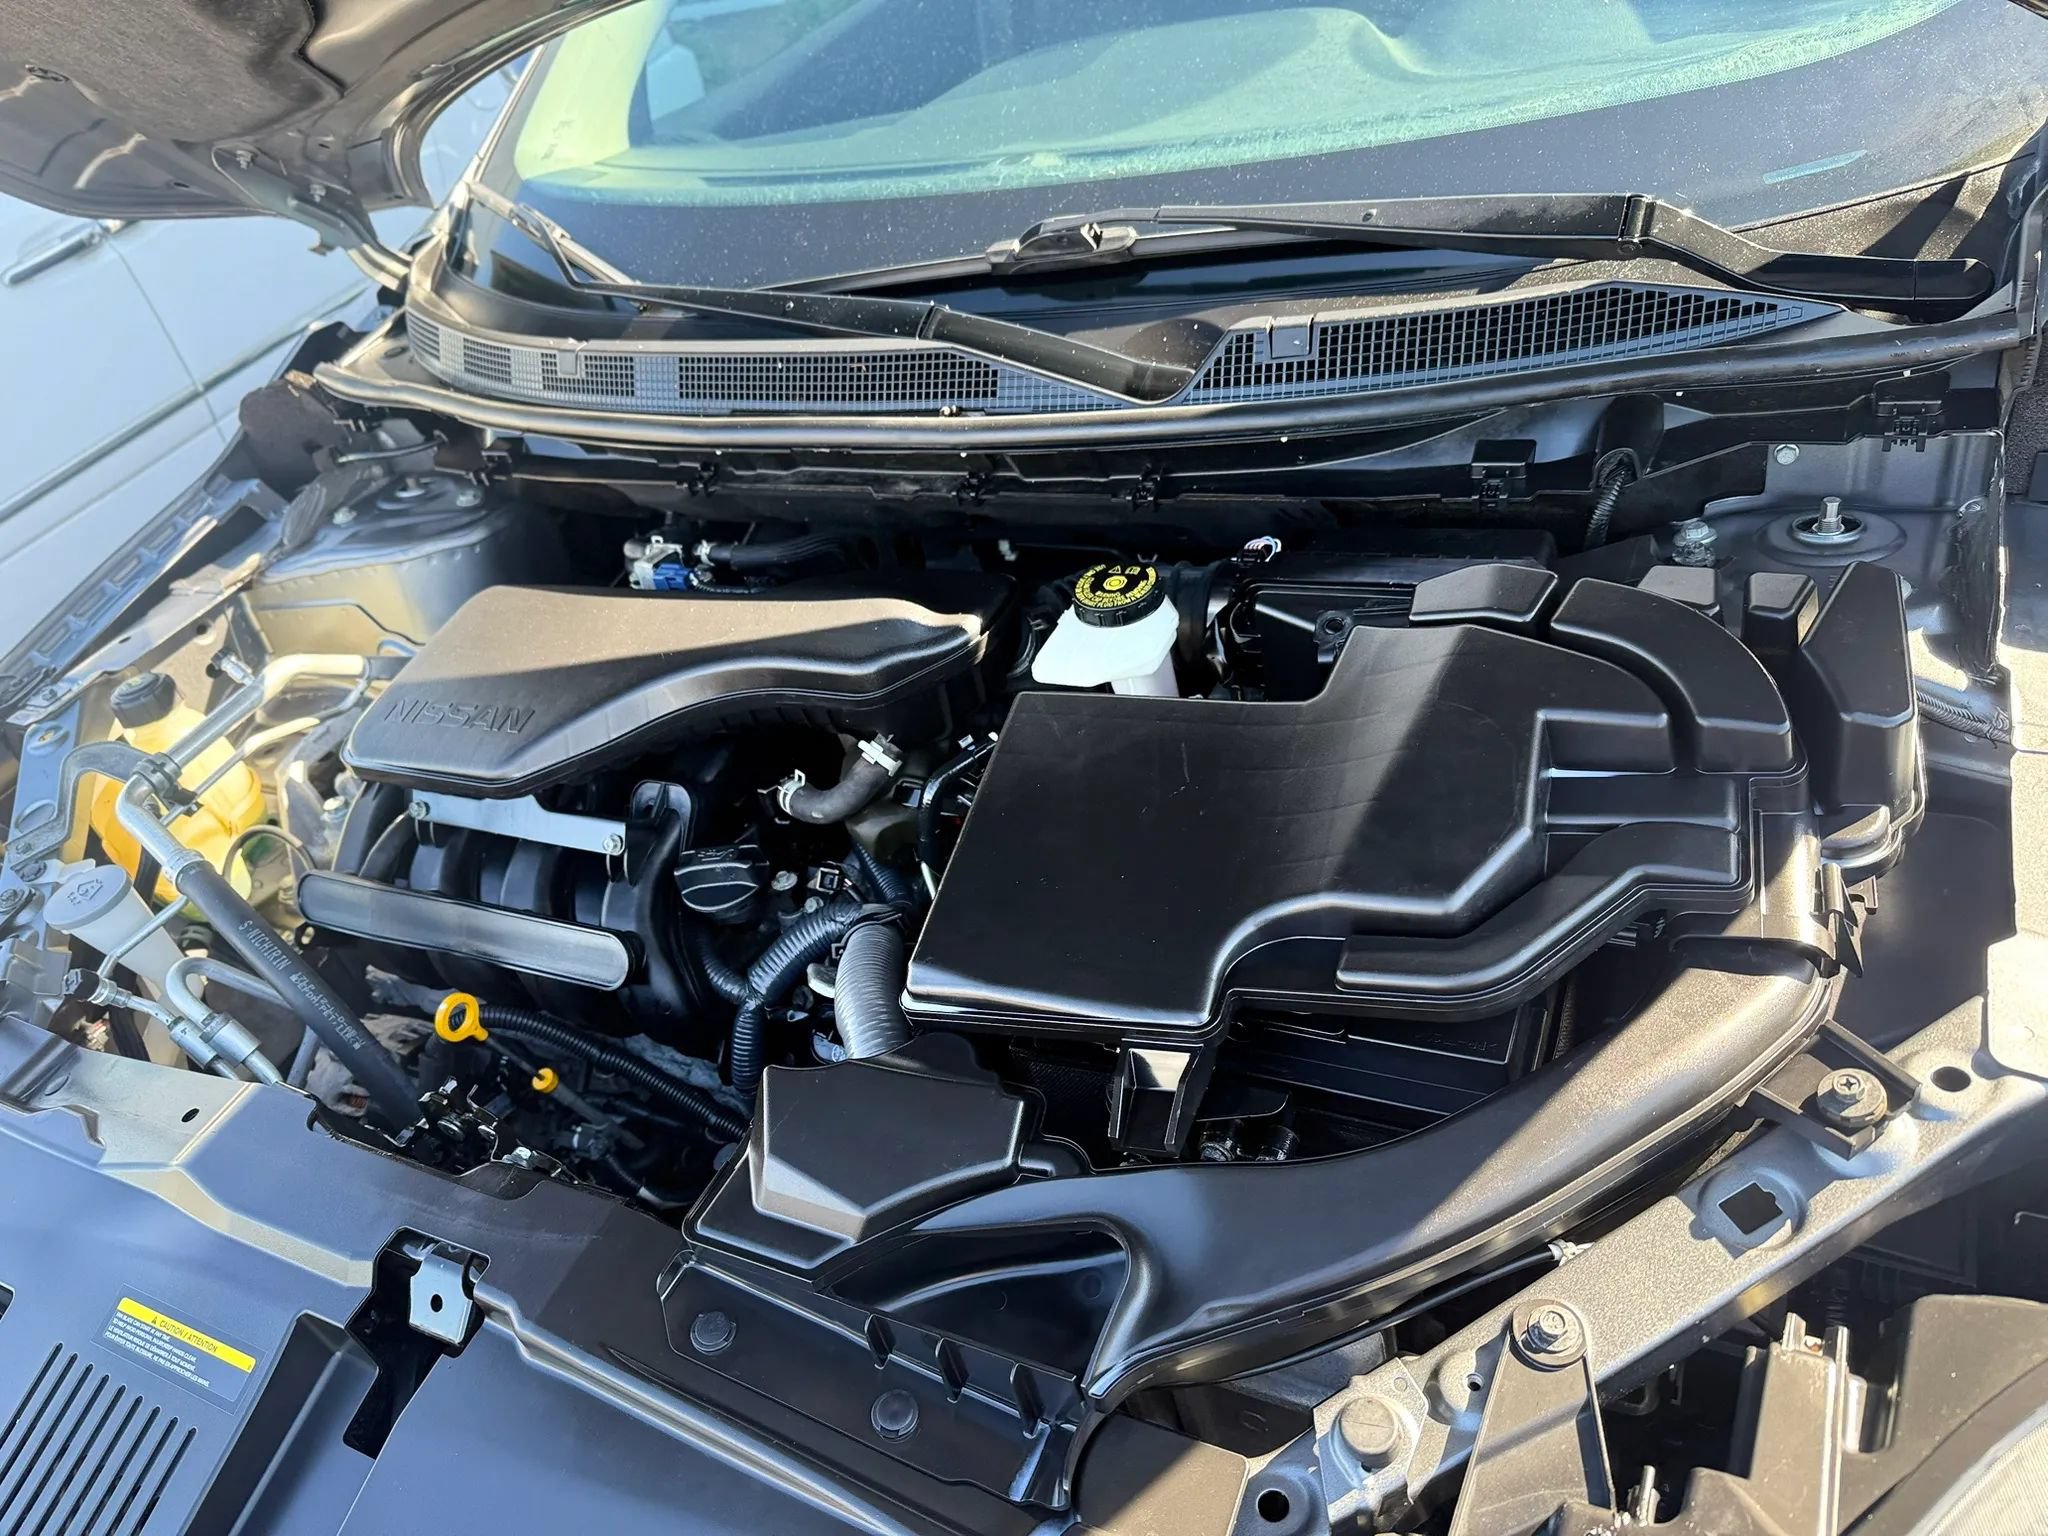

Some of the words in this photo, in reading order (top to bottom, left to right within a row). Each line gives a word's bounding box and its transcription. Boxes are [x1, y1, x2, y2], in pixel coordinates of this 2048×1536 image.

[384, 699, 536, 734] NISSAN
[159, 1319, 184, 1338] CAUTION
[187, 1333, 218, 1353] ATTENTION
